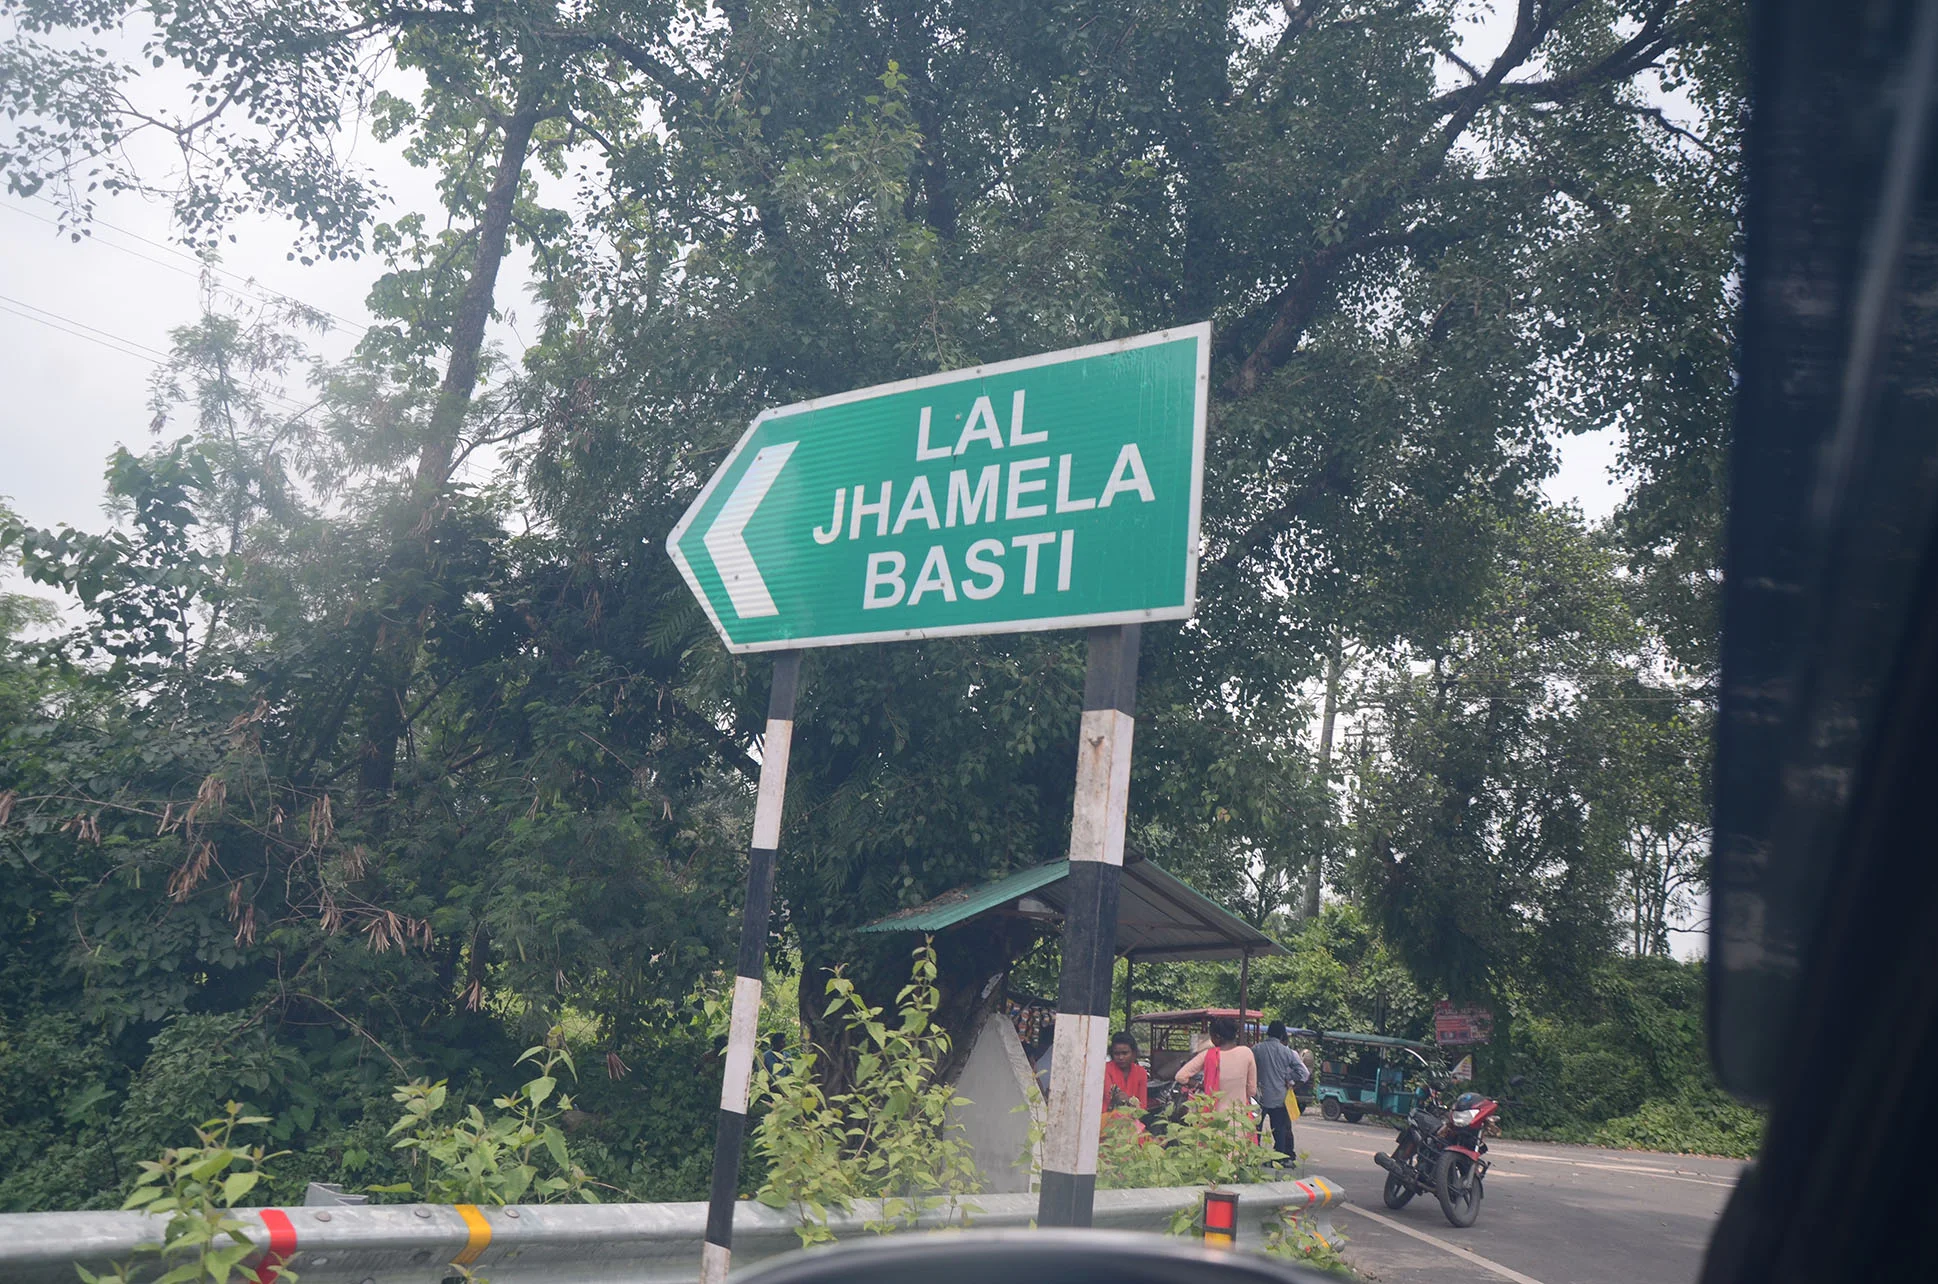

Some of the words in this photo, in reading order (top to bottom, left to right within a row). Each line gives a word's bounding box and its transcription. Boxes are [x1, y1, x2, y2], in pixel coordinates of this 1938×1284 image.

[916, 389, 1049, 462] LAL
[812, 443, 1156, 545] JHAMELA
[863, 529, 1075, 610] BASTI
